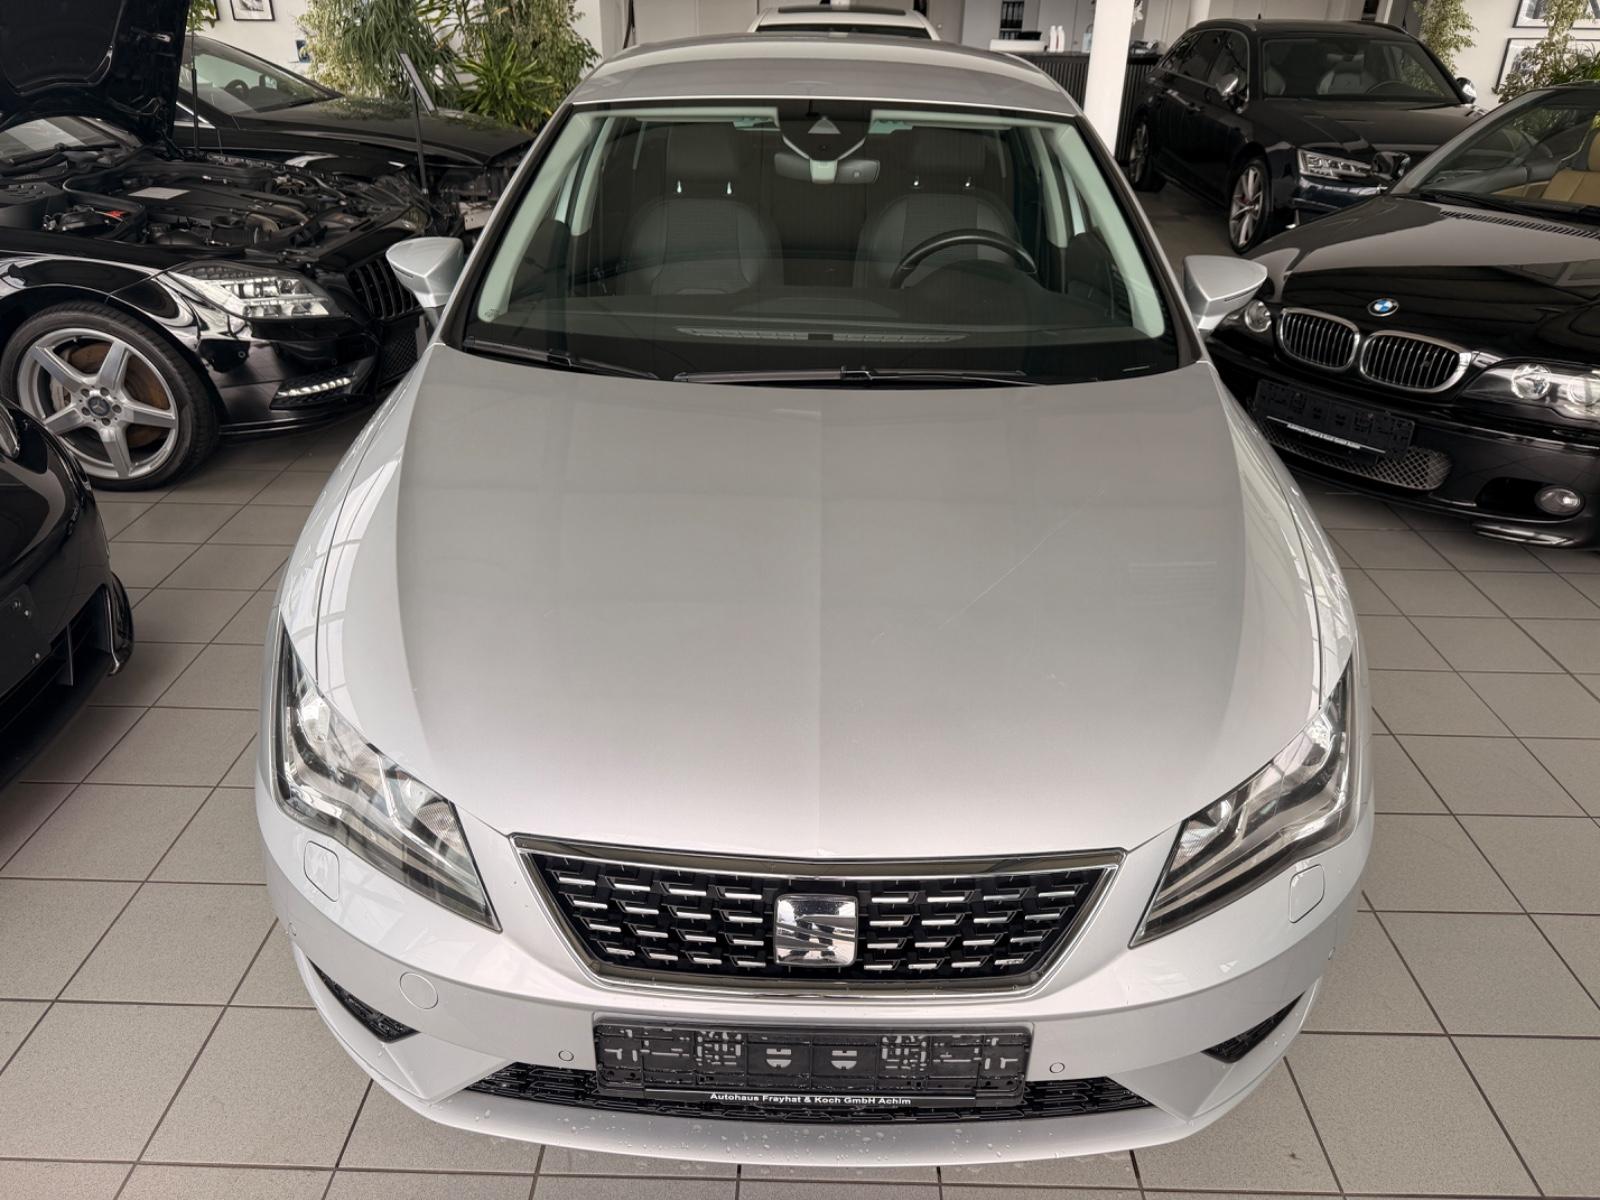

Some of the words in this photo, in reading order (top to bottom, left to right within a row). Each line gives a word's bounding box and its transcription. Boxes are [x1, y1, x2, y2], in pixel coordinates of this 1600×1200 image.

[710, 1092, 760, 1102] Autohaus
[762, 1095, 801, 1104] Frayhat
[803, 1096, 812, 1104] &
[814, 1096, 841, 1105] Koch
[844, 1097, 876, 1105] GmbH
[878, 1097, 911, 1105] Achim
